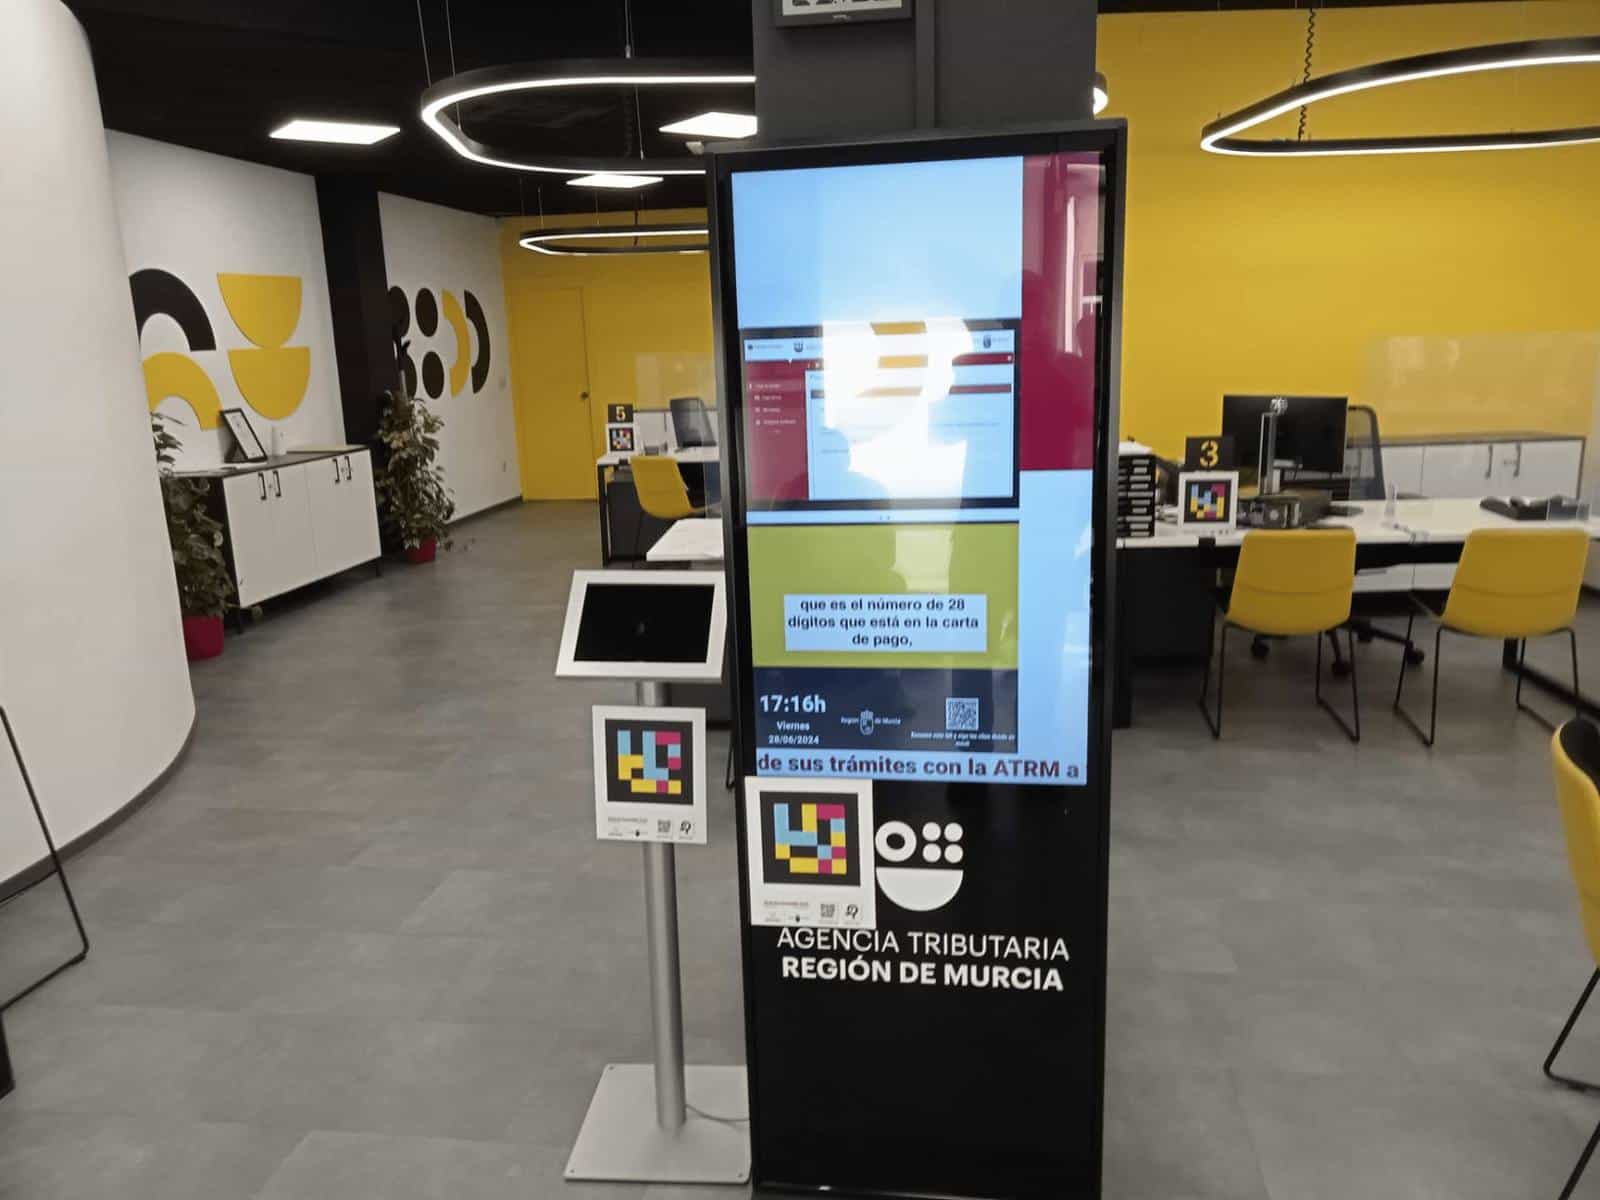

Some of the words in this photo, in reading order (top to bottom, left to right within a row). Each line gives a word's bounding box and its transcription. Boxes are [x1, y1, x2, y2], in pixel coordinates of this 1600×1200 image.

[616, 406, 626, 421] 5
[1199, 440, 1219, 467] 3
[800, 599, 826, 612] que
[830, 601, 846, 610] es
[851, 598, 863, 610] el
[867, 598, 922, 610] número
[926, 598, 944, 610] de
[948, 599, 965, 610] 28
[840, 617, 866, 630] que
[870, 615, 899, 628] está
[904, 618, 921, 628] en
[926, 615, 938, 628] la
[942, 616, 979, 628] carta
[852, 633, 869, 645] de
[873, 635, 913, 647] pago,
[760, 694, 826, 713] 17:16h
[776, 721, 810, 731] Viernes
[768, 735, 819, 745] 28/06/2024
[758, 754, 782, 770] de
[788, 758, 823, 772] sus
[830, 755, 917, 773] trámites
[923, 760, 961, 775] con
[968, 758, 986, 775] la
[993, 759, 1060, 777] ATRM
[1067, 765, 1079, 778] a
[777, 926, 900, 953] AGENCIA
[907, 931, 1070, 961] TRIBUTARIA
[782, 954, 891, 983] REGIÓN
[899, 961, 936, 984] DE
[944, 963, 1064, 991] MURCIA
